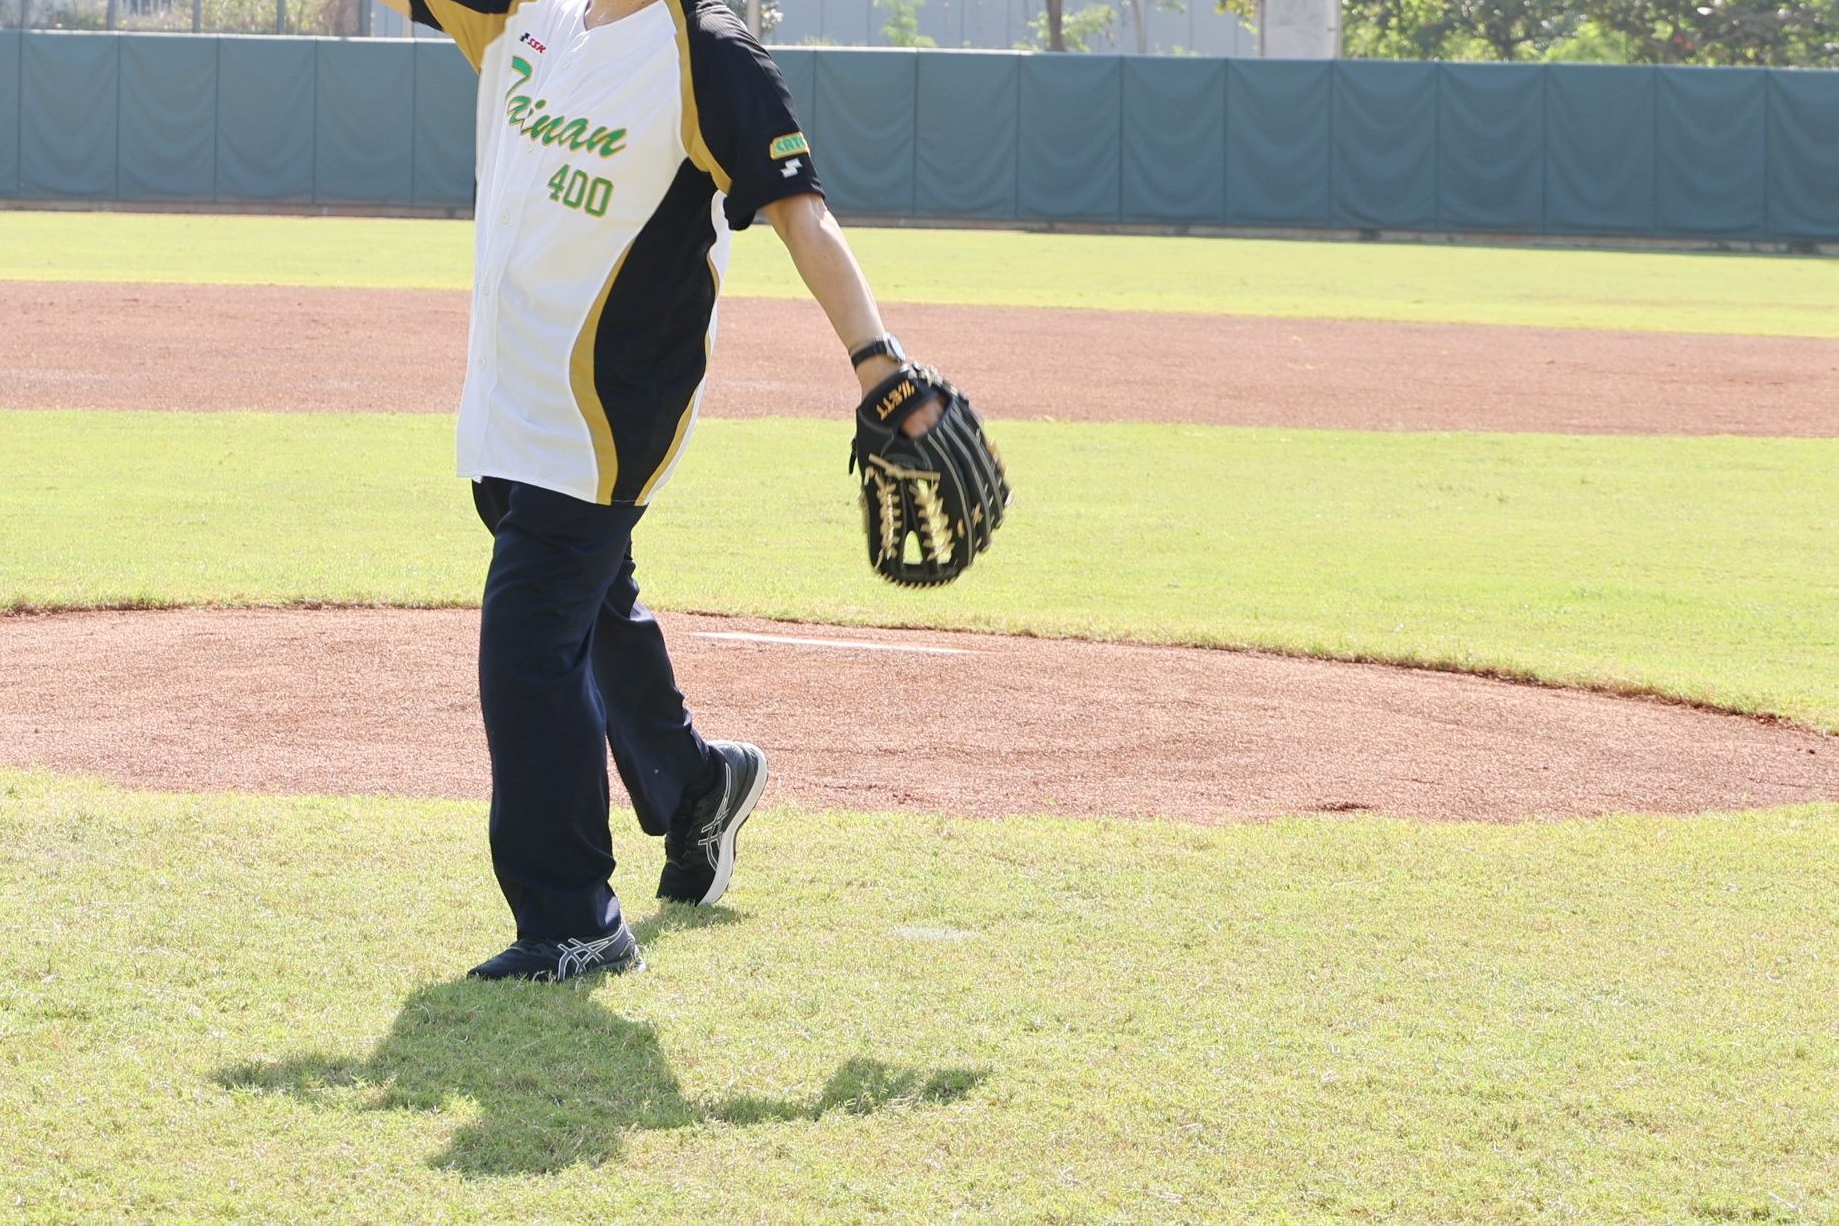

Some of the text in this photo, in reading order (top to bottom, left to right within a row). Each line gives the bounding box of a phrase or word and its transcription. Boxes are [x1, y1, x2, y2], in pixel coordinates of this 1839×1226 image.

[527, 37, 547, 54] SSK
[505, 54, 628, 159] Tainan
[546, 163, 615, 219] 400
